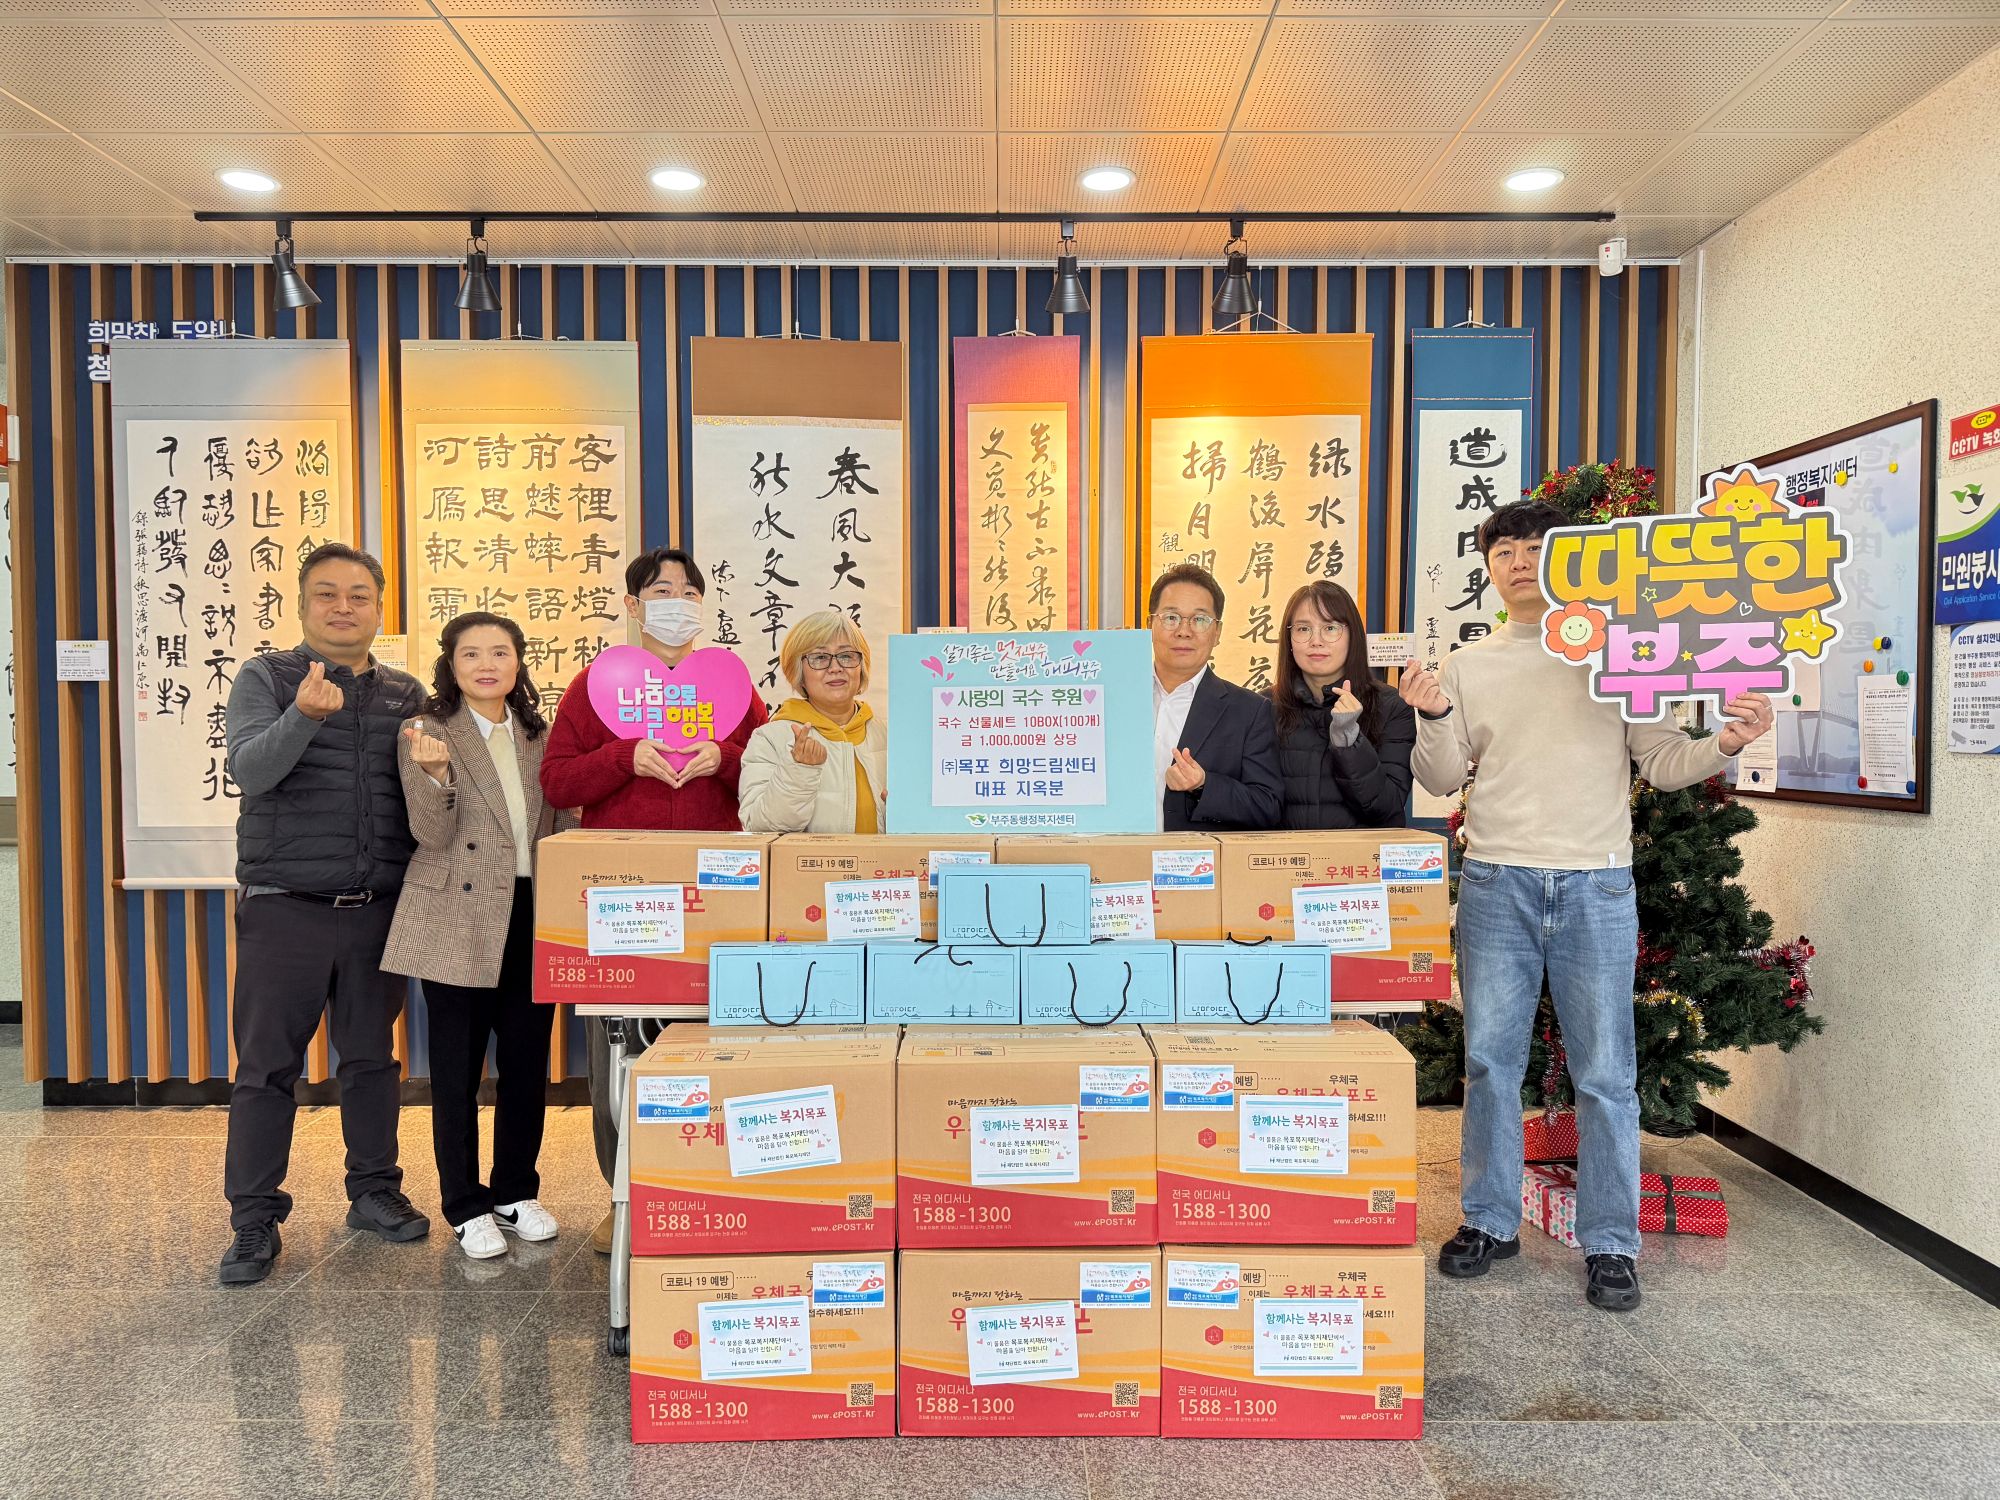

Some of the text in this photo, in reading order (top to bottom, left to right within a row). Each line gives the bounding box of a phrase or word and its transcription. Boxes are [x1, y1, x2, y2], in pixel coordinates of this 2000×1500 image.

[1952, 435, 1979, 455] CCTV
[1549, 517, 1840, 619] 따뜻한
[1958, 635, 1974, 645] CCTV
[945, 644, 994, 664] 살기좋은
[990, 664, 1037, 682] 만들어요
[1600, 621, 1782, 713] 부주
[958, 689, 1082, 707] 사랑의 국수 후원
[618, 707, 643, 722] 더
[938, 717, 961, 728] 국수
[969, 716, 1016, 727] 선물세트
[961, 735, 972, 746] 금
[1054, 734, 1076, 745] 상당
[1000, 758, 1095, 774] 희망드림센터
[976, 780, 1063, 797] 대표 지옥분
[991, 814, 1074, 825] 부주동행정복지센터
[801, 859, 823, 868] 코로나
[838, 859, 854, 868] 예방
[1252, 856, 1306, 866] 코로나 19 예방
[581, 874, 644, 883] 마음까지 전하는
[873, 870, 929, 882] 우체국소
[1326, 866, 1381, 879] 우체국소
[836, 889, 911, 902] 함께사는 복지목포
[1105, 894, 1144, 907] 복지목포
[599, 901, 675, 913] 함께사는 복지목포
[1304, 900, 1380, 913] 함께사는 복지목포
[548, 956, 600, 966] 전국 어디서나
[1236, 1075, 1358, 1086] 예방 우체국
[948, 1098, 987, 1109] 마음까지
[738, 1108, 827, 1128] 함께사는 복지목포
[1252, 1114, 1339, 1128] 함께사는 복지목포
[1348, 1114, 1386, 1122] 하세요!!!
[982, 1120, 1021, 1131] 함께사는
[1023, 1118, 1069, 1132] 복지목포
[913, 1194, 971, 1204] 전국 어디서나
[1172, 1189, 1230, 1200] 전국 어디서나
[647, 1201, 706, 1211] 전국 어디서나
[666, 1276, 728, 1287] 코로나 19 예방
[1243, 1272, 1367, 1283] 예방 우체국
[952, 1290, 1023, 1301] 마음까지 전하는
[1249, 1290, 1270, 1298] 이제는
[712, 1316, 800, 1330] 함께사는 복지목포
[979, 1319, 1017, 1331] 함께사는
[1020, 1315, 1066, 1329] 복지목포
[1266, 1312, 1354, 1326] 함께사는 복지목포
[916, 1383, 974, 1394] 전국 어디서나
[1178, 1386, 1237, 1396] 전국 어디서나
[648, 1390, 707, 1400] 전국 어디서나
